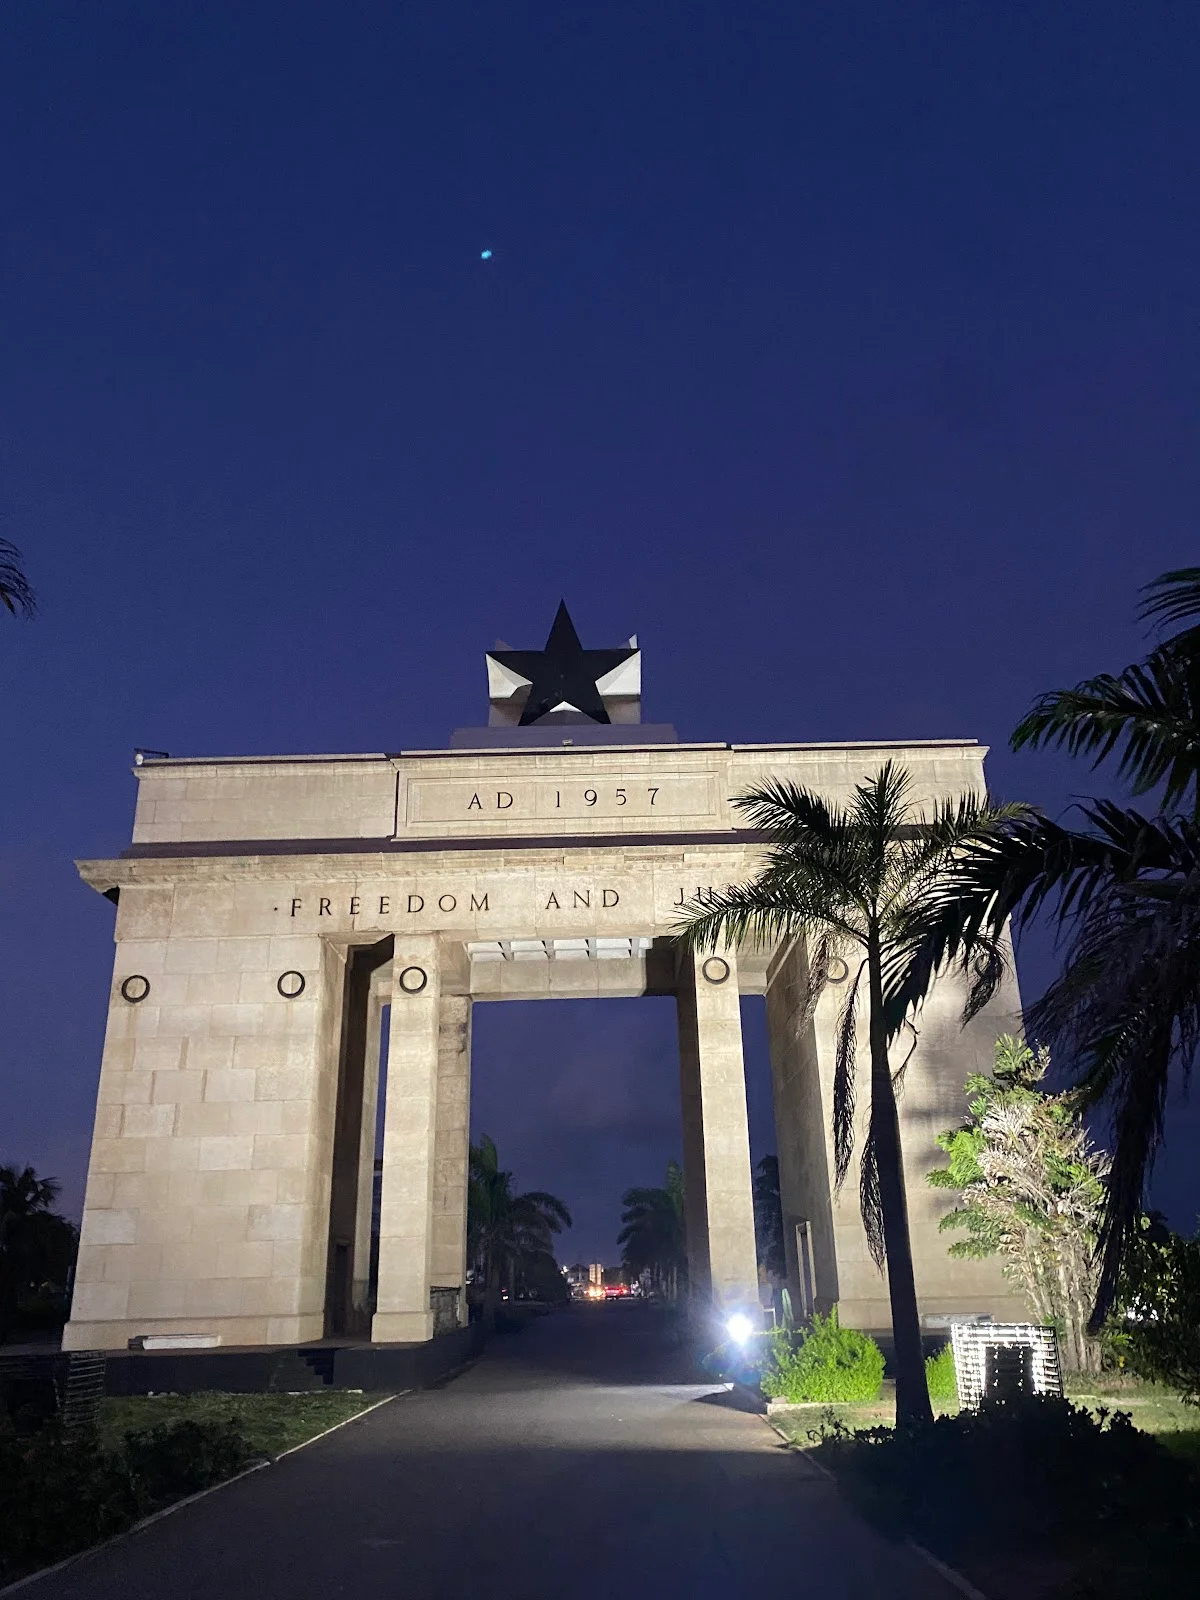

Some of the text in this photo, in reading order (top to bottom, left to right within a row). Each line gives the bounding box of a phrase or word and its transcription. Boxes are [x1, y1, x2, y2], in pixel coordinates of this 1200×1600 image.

[467, 787, 660, 810] AD 1957
[290, 889, 620, 917] FREEDOM AND
